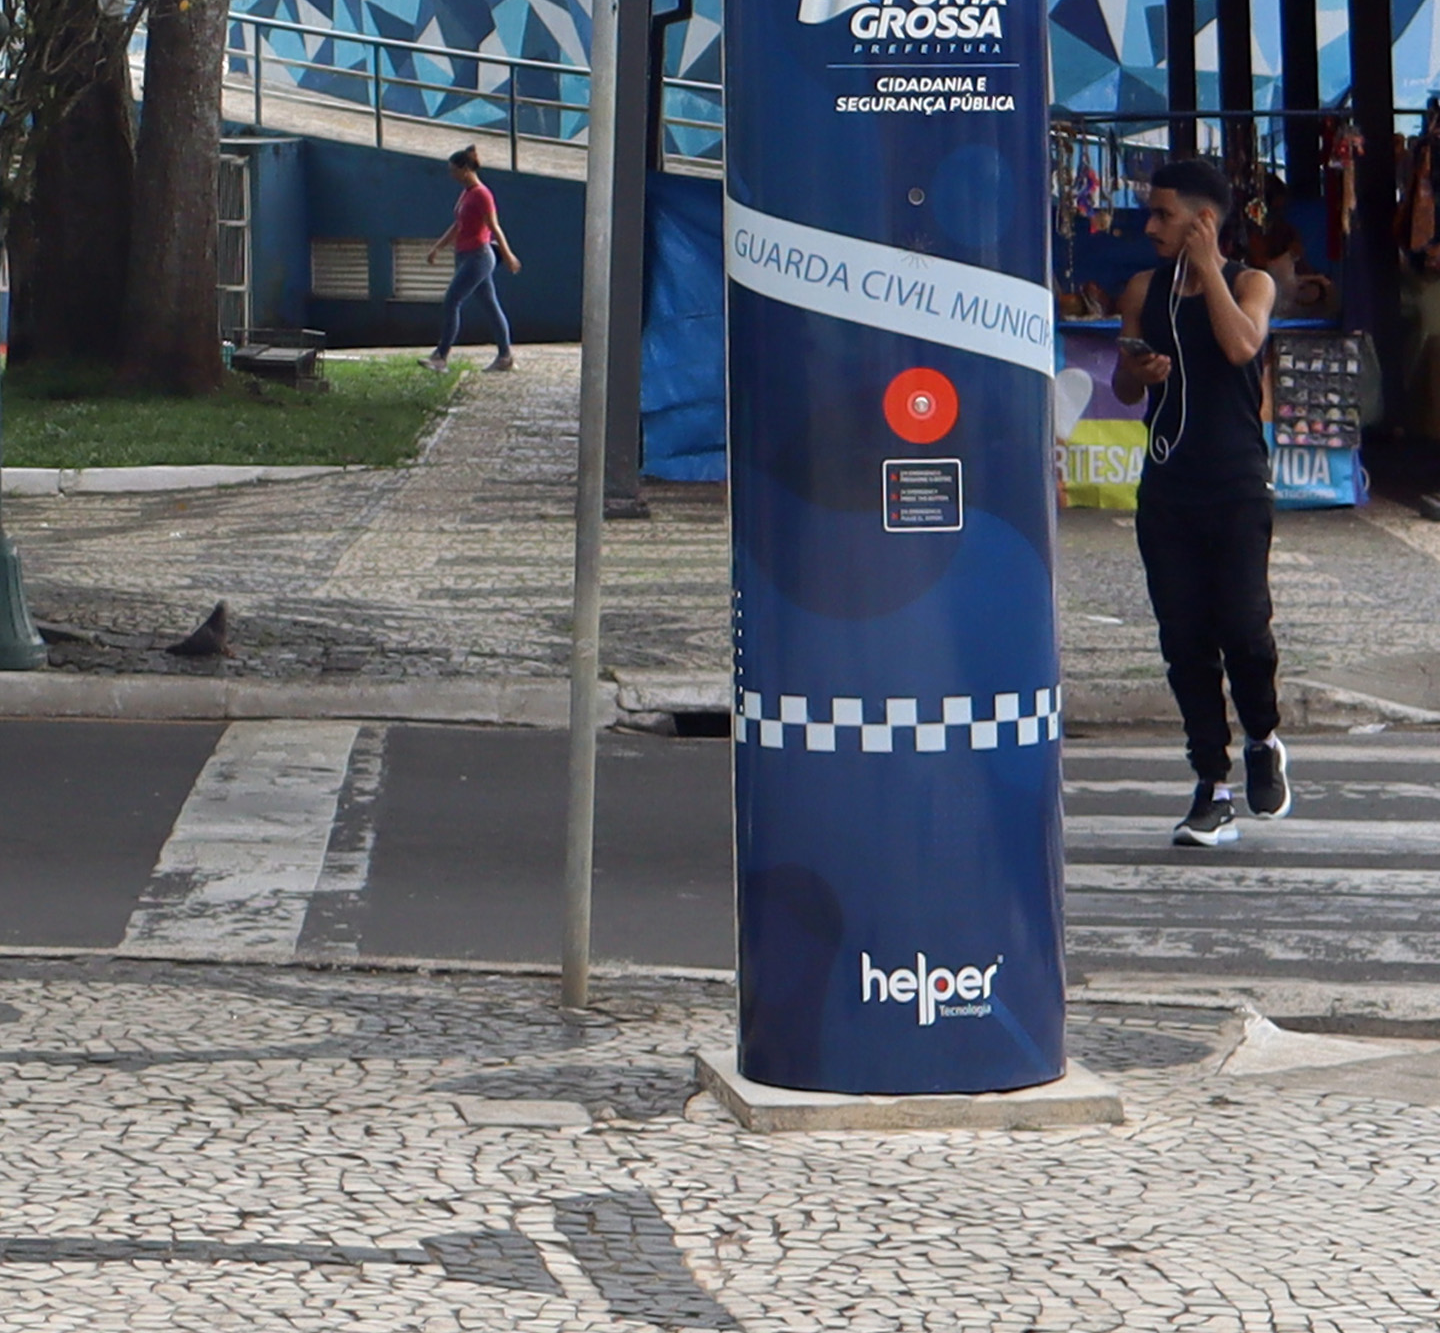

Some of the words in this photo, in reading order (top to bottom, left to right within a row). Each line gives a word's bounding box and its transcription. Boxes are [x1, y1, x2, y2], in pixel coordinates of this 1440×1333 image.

[850, 6, 1003, 39] GROSSA
[853, 43, 1001, 54] PREFEITURA
[876, 77, 974, 93] CIDADANIA
[976, 76, 987, 92] E
[835, 96, 947, 115] SEGURANÇA
[949, 93, 1016, 112] PÚBLICA
[734, 229, 849, 293] GUARDA
[861, 270, 940, 317] CIVIL
[950, 291, 1051, 349] MUNICIP
[861, 951, 998, 1026] helper
[938, 1004, 992, 1018] Tecnologia
